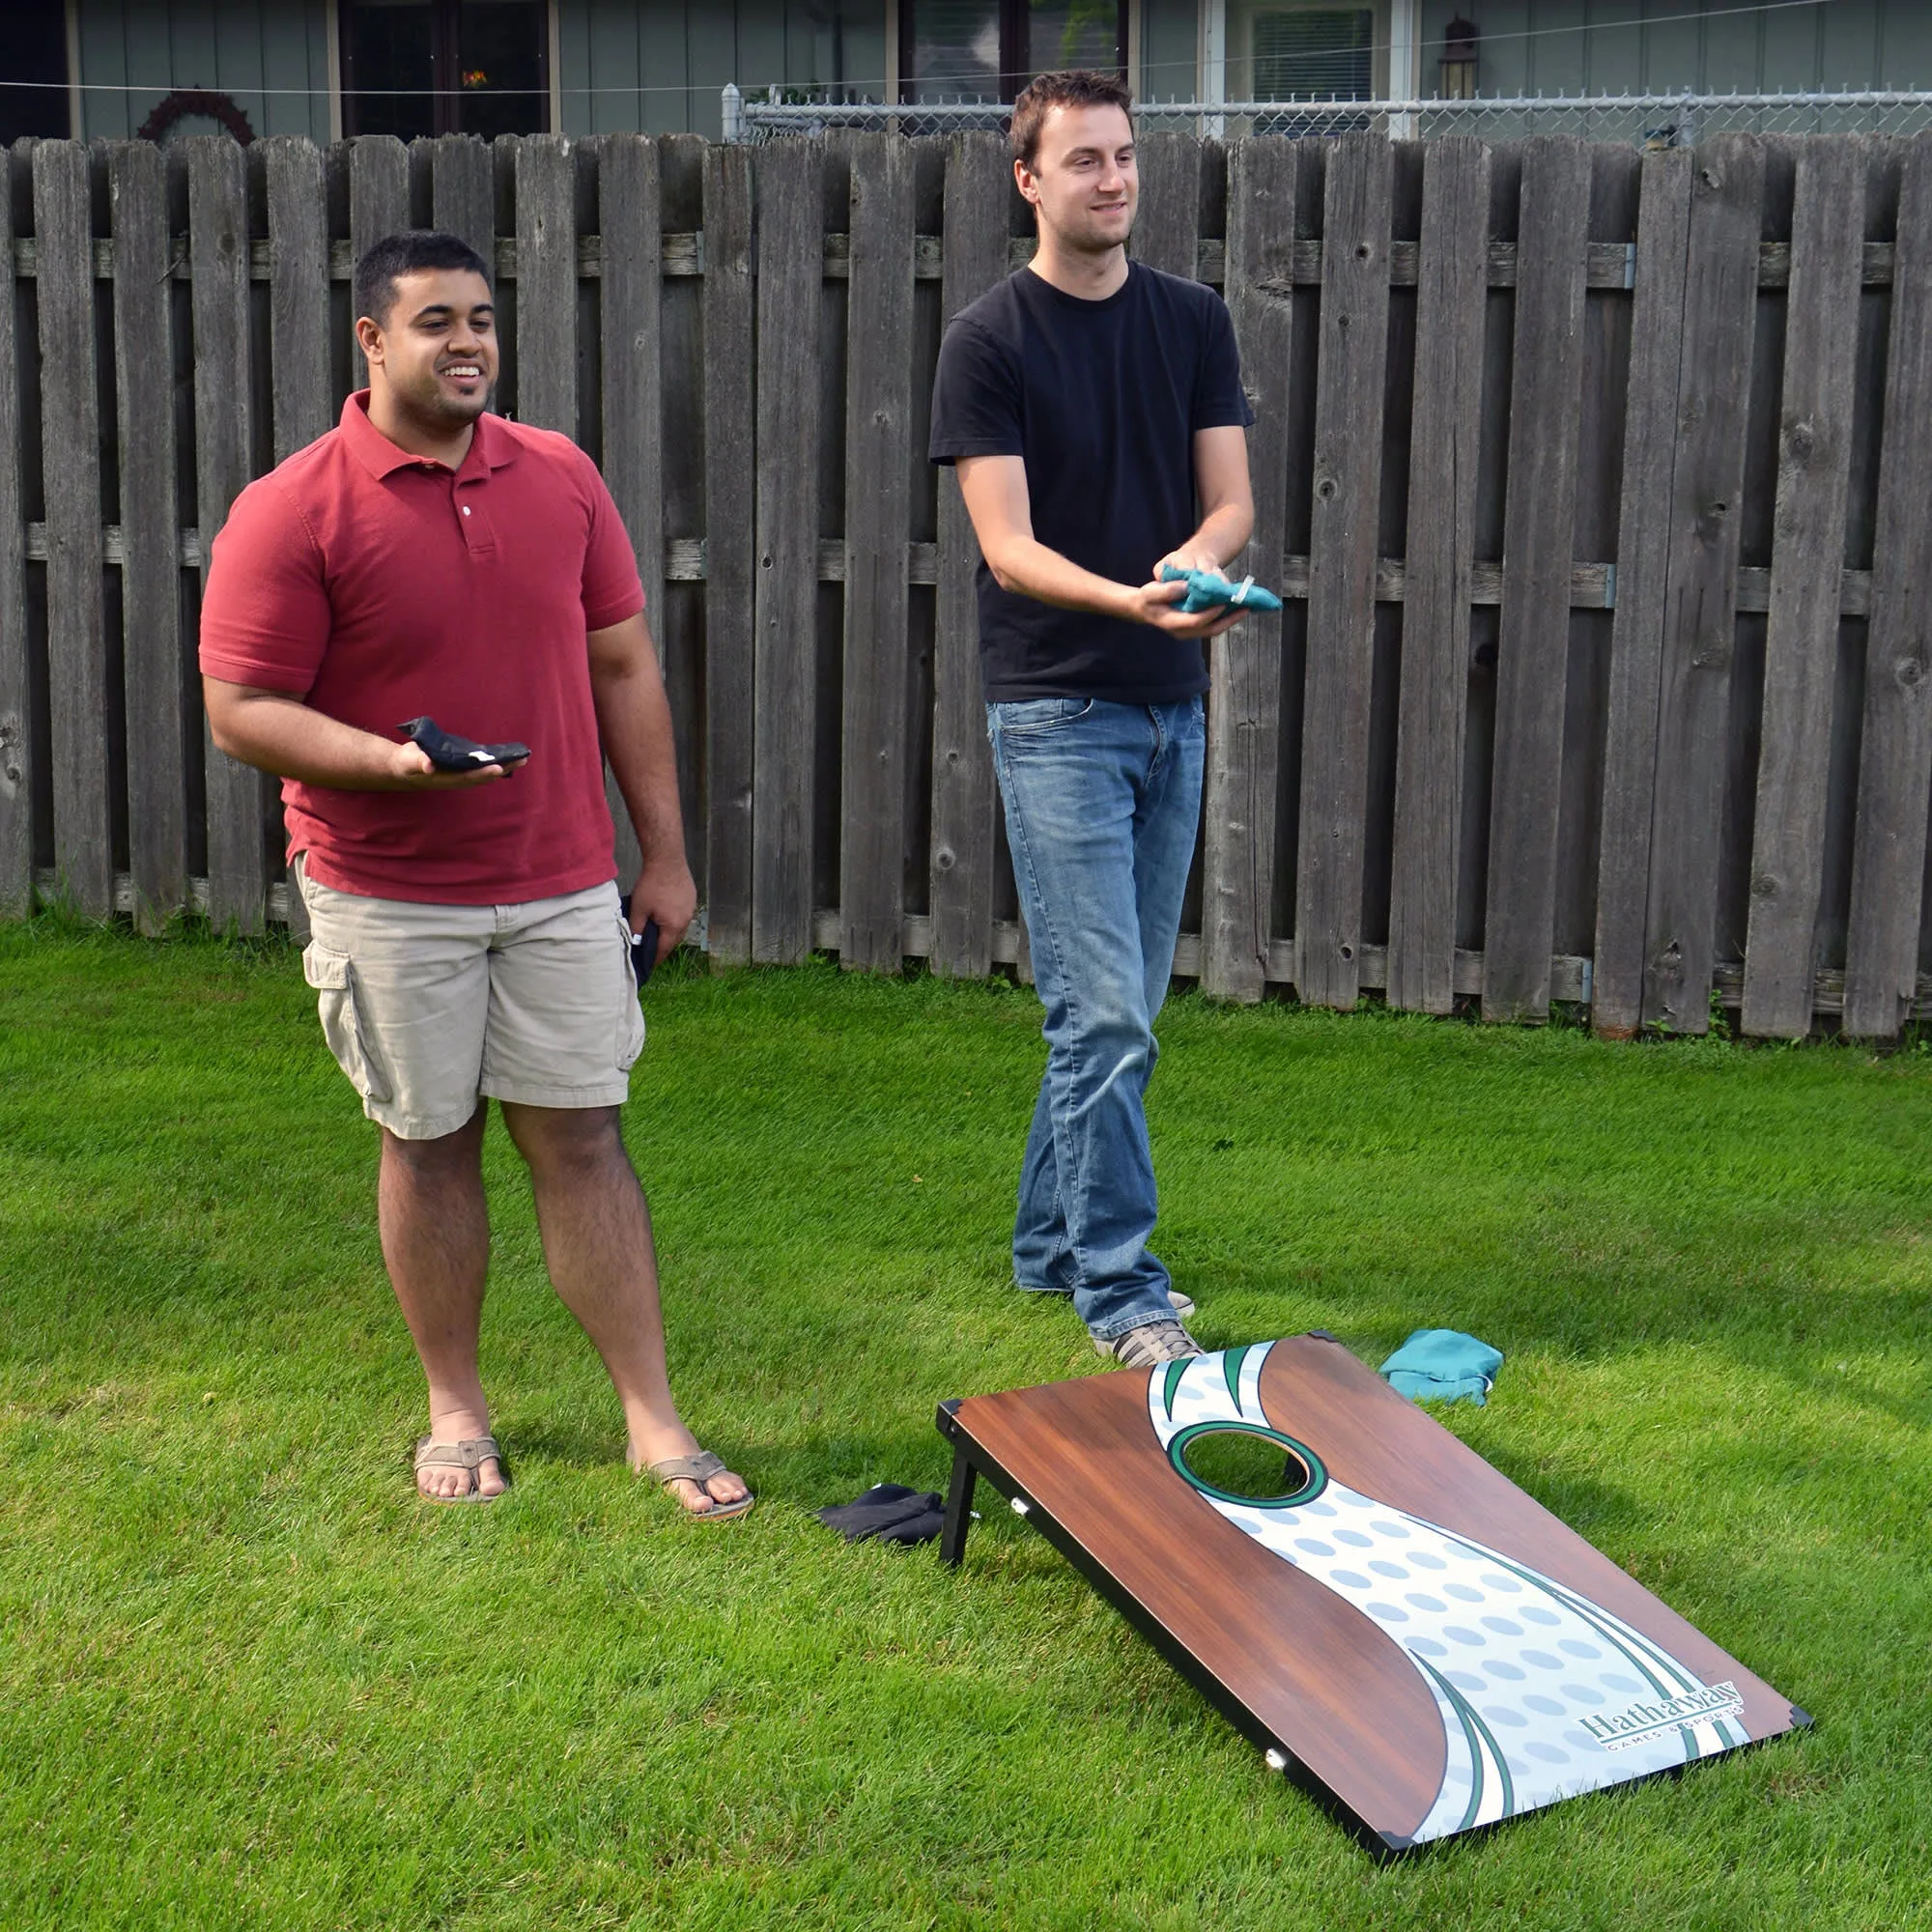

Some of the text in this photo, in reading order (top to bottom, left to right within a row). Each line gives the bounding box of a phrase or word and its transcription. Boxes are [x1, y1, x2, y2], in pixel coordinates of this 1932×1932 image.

[1579, 1683, 1743, 1738] Hathaway
[1607, 1731, 1662, 1751] GAMES
[1685, 1707, 1744, 1730] SPORTS
